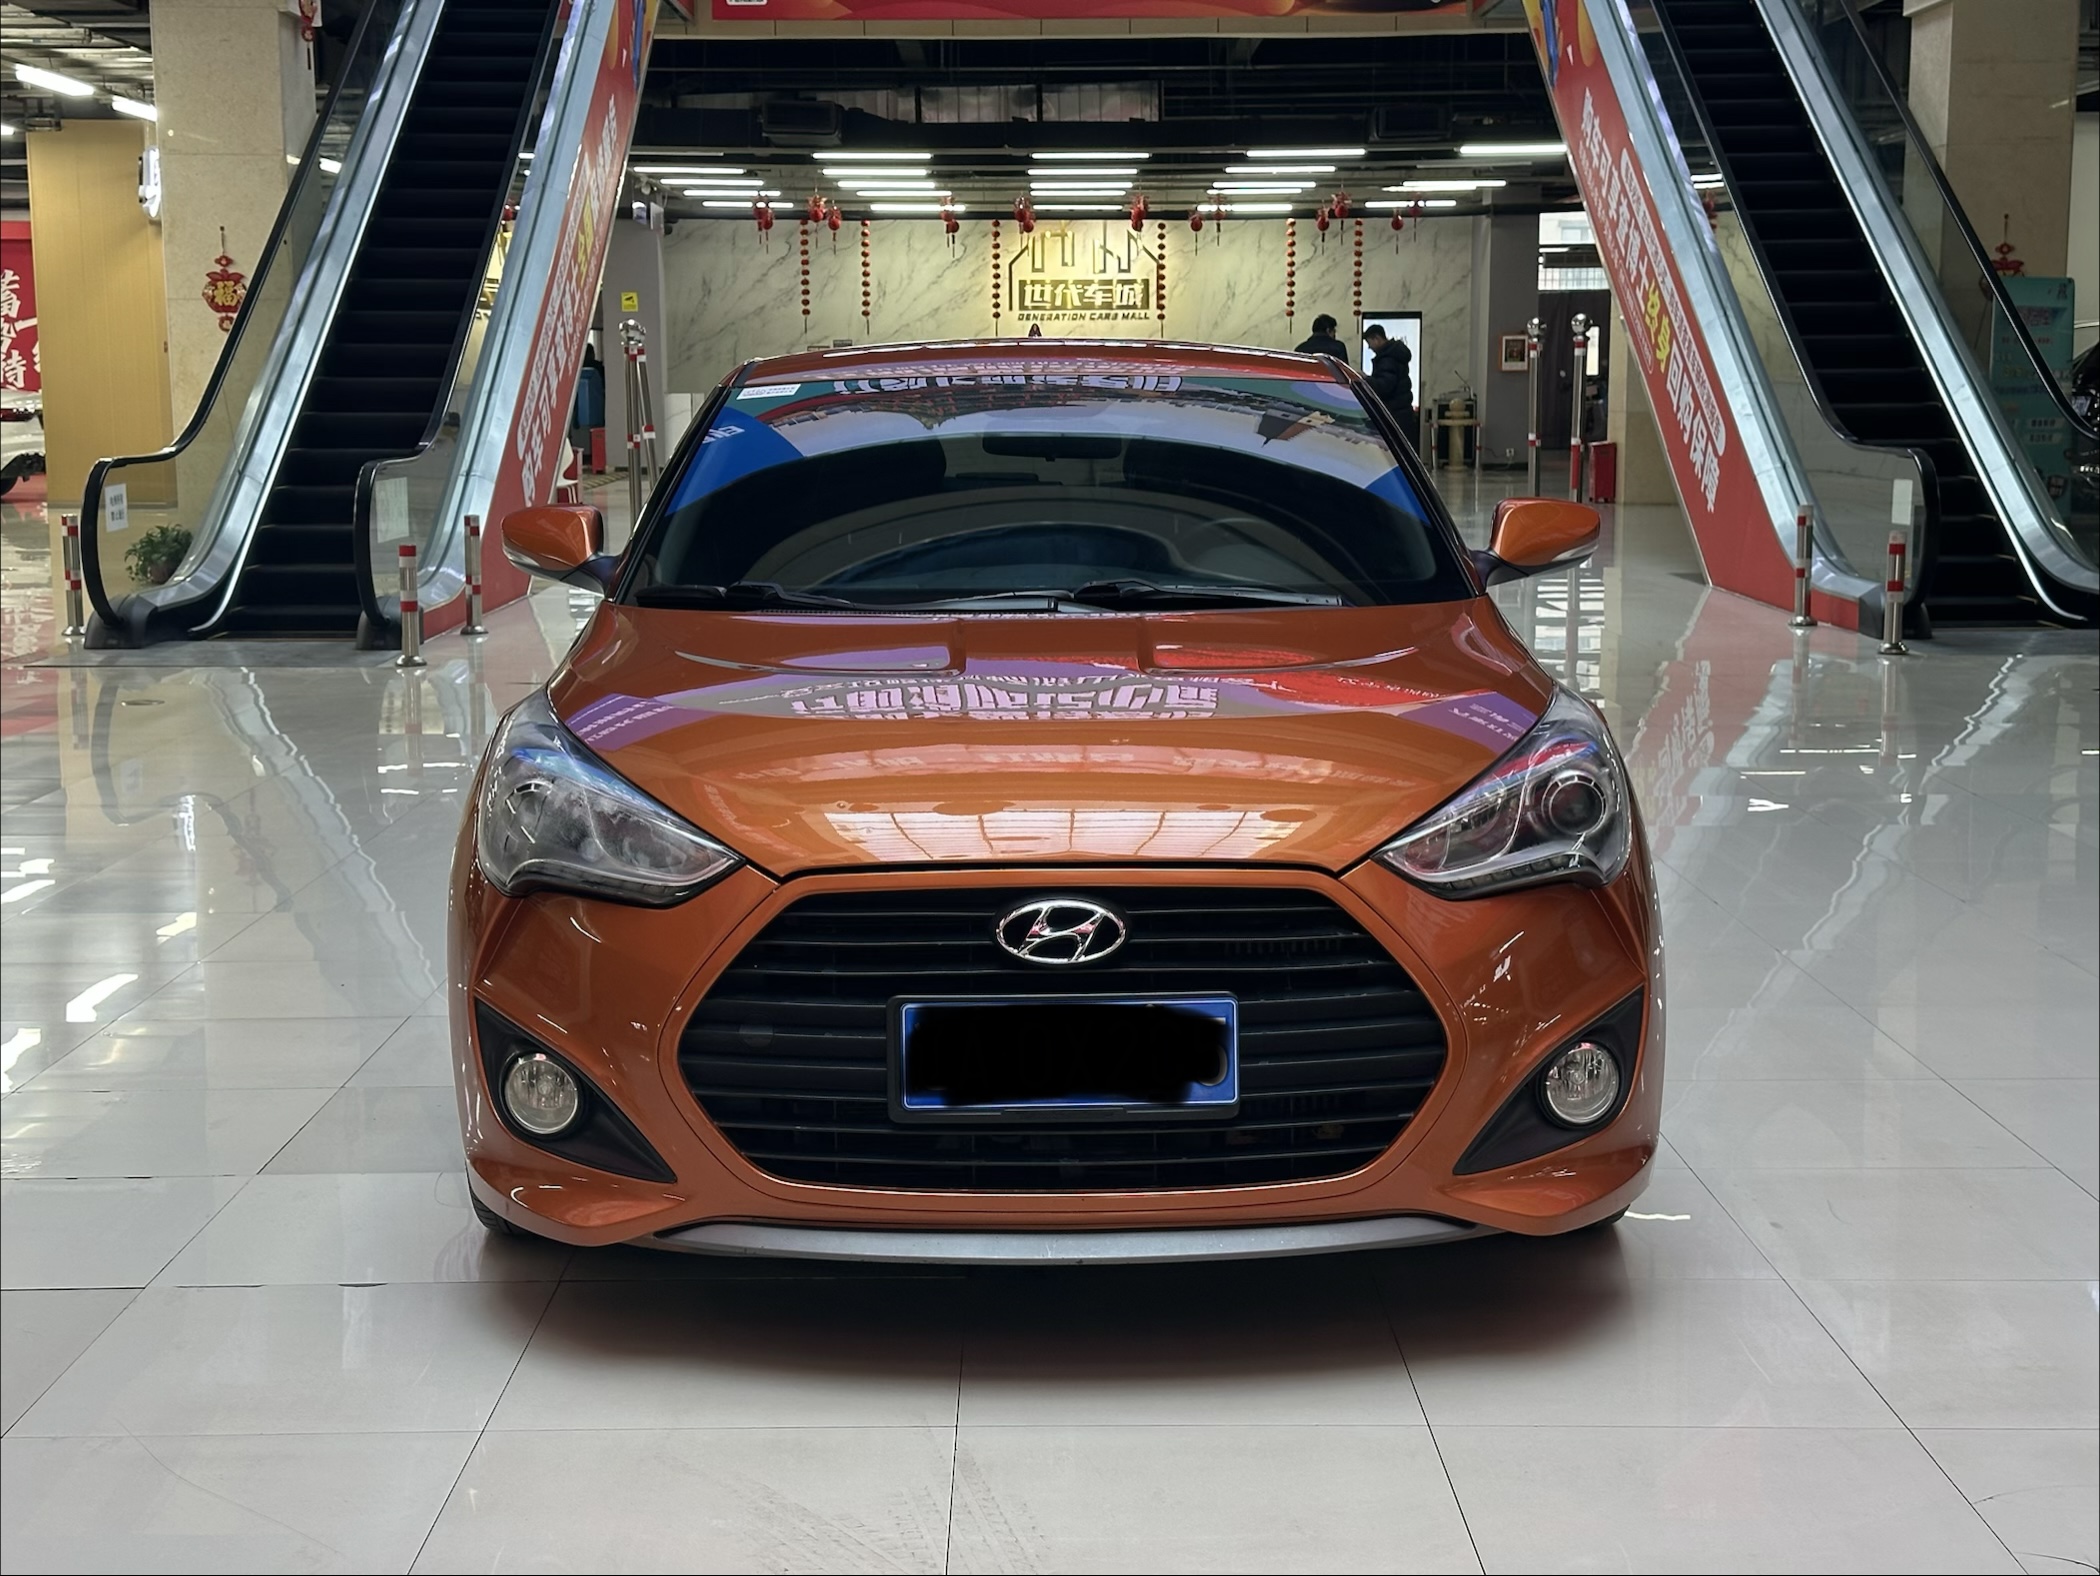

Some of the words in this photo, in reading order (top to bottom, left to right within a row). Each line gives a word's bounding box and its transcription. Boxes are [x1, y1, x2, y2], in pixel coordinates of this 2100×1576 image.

[214, 280, 238, 307] 福
[1023, 282, 1145, 309] 世代车城
[1582, 86, 1720, 514] 购车可享查博士终身回购保障
[1017, 312, 1087, 322] GENERATION
[1089, 312, 1119, 322] CARS
[1121, 312, 1150, 322] MALL
